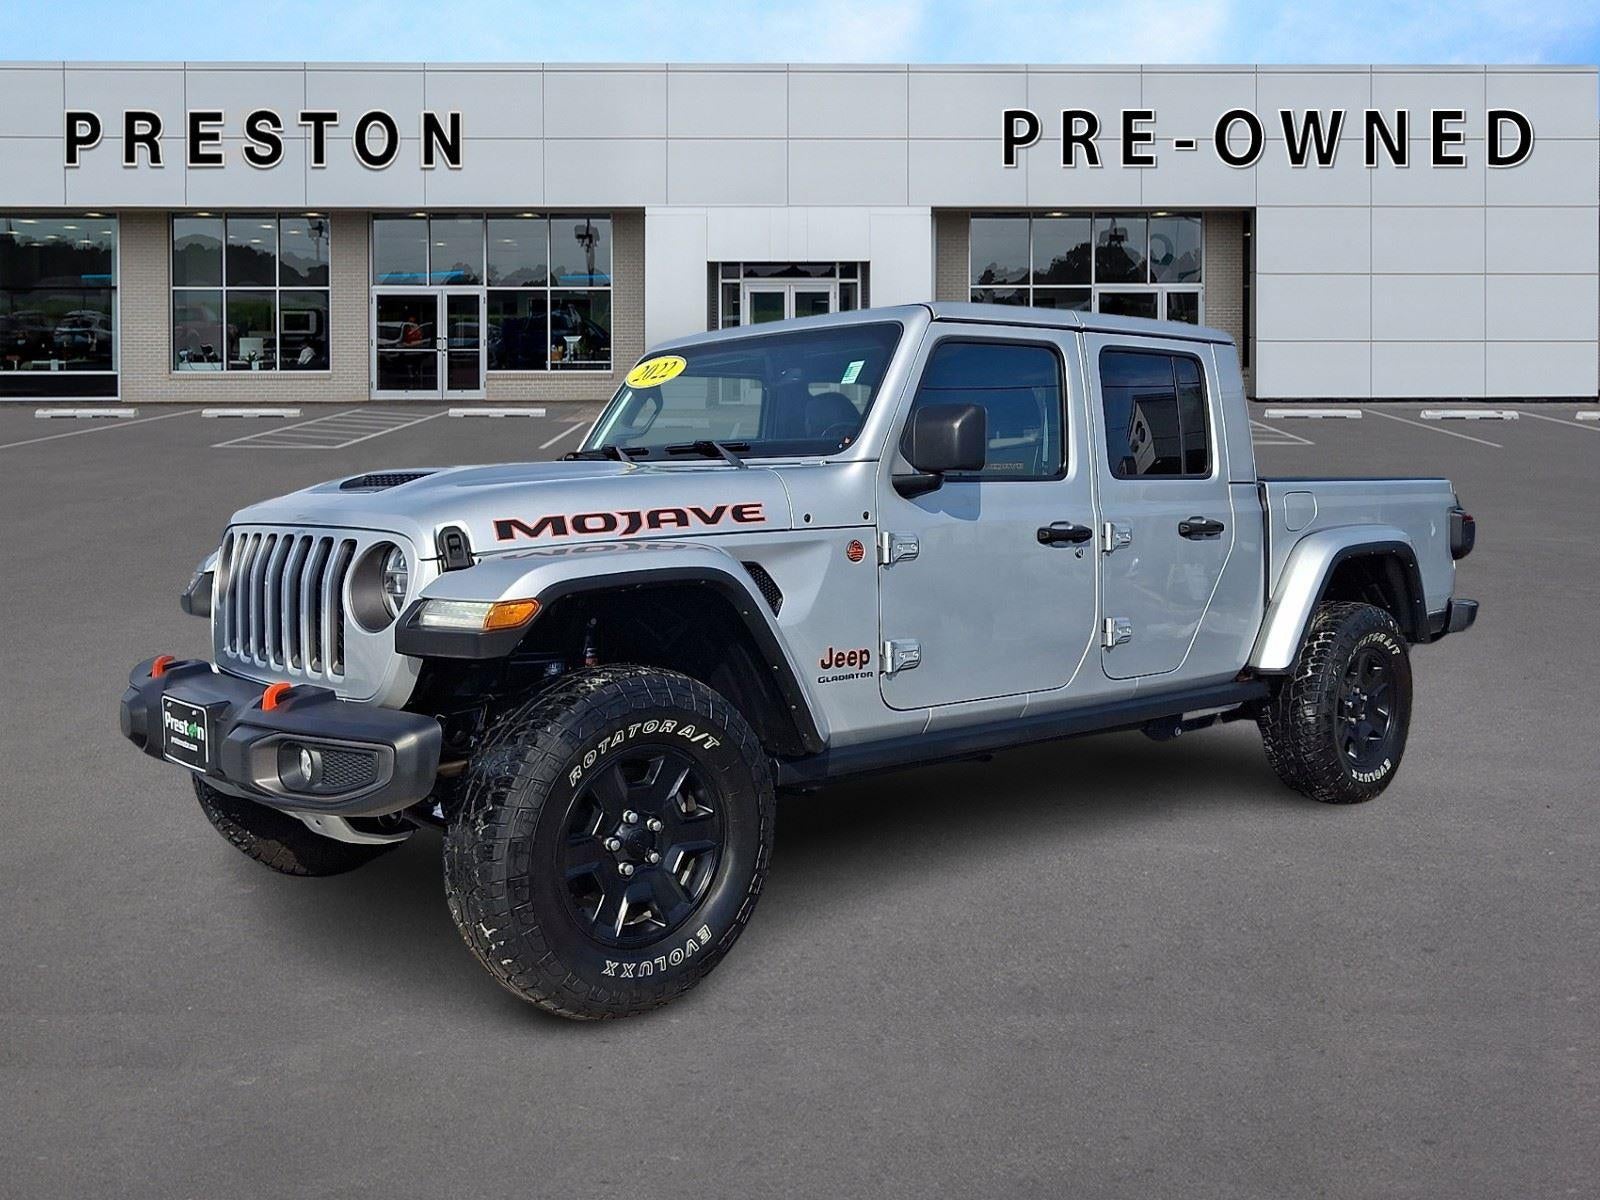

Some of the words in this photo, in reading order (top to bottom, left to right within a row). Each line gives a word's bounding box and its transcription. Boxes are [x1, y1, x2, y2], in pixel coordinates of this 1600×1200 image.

[64, 109, 463, 169] PRESTON
[1002, 109, 1535, 169] PRE-OWNED
[631, 360, 678, 383] 2022
[493, 502, 766, 541] MOJAVE
[817, 671, 874, 684] GLADIATOR
[819, 647, 871, 671] Jeep
[568, 719, 678, 787] ROTATOR
[677, 724, 721, 750] A/T
[601, 924, 713, 979] EVOLUXX
